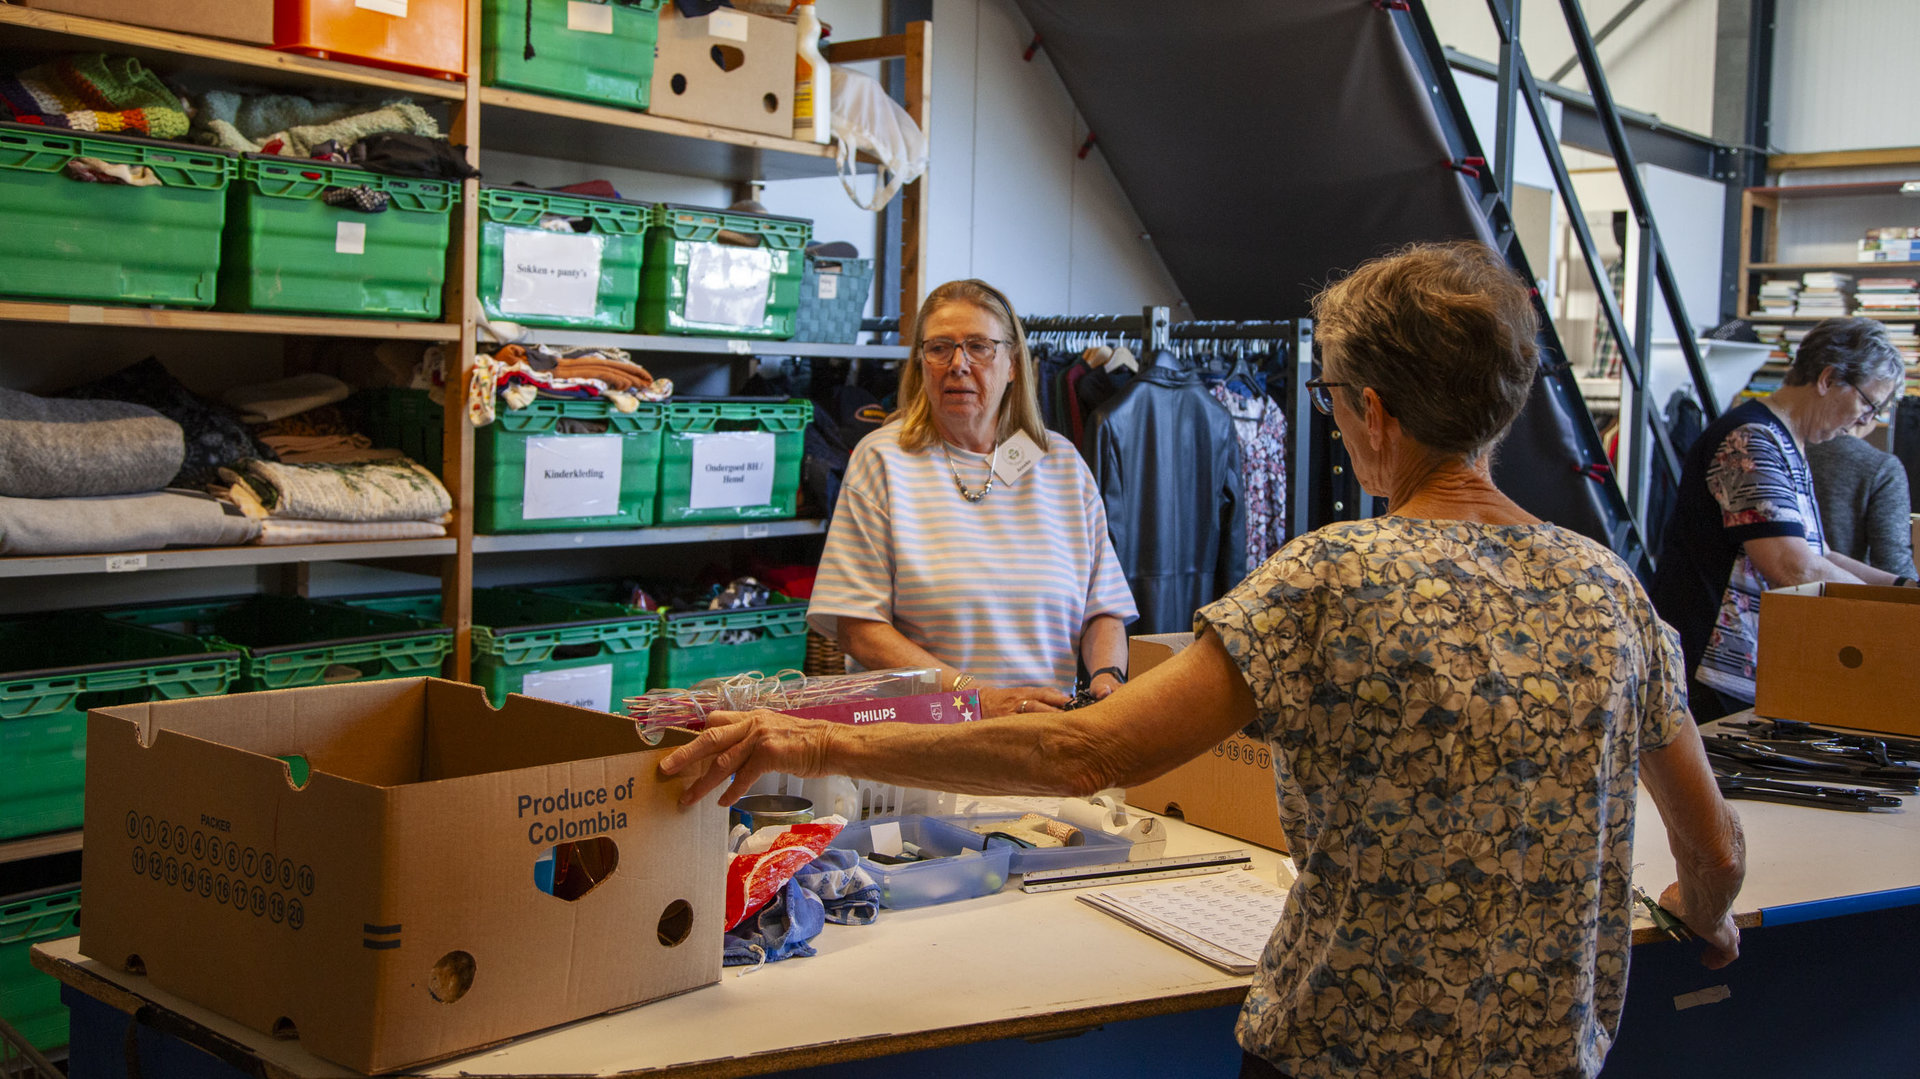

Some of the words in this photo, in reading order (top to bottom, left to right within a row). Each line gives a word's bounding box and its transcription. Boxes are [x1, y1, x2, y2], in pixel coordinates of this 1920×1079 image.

[516, 263, 548, 275] Sokken
[544, 468, 604, 480] Kinderkleding
[723, 475, 745, 483] Hemd
[853, 707, 896, 723] PHILIPS
[517, 788, 608, 818] Produce
[613, 777, 635, 801] of
[201, 814, 231, 832] PACKER
[528, 809, 628, 845] Colombia
